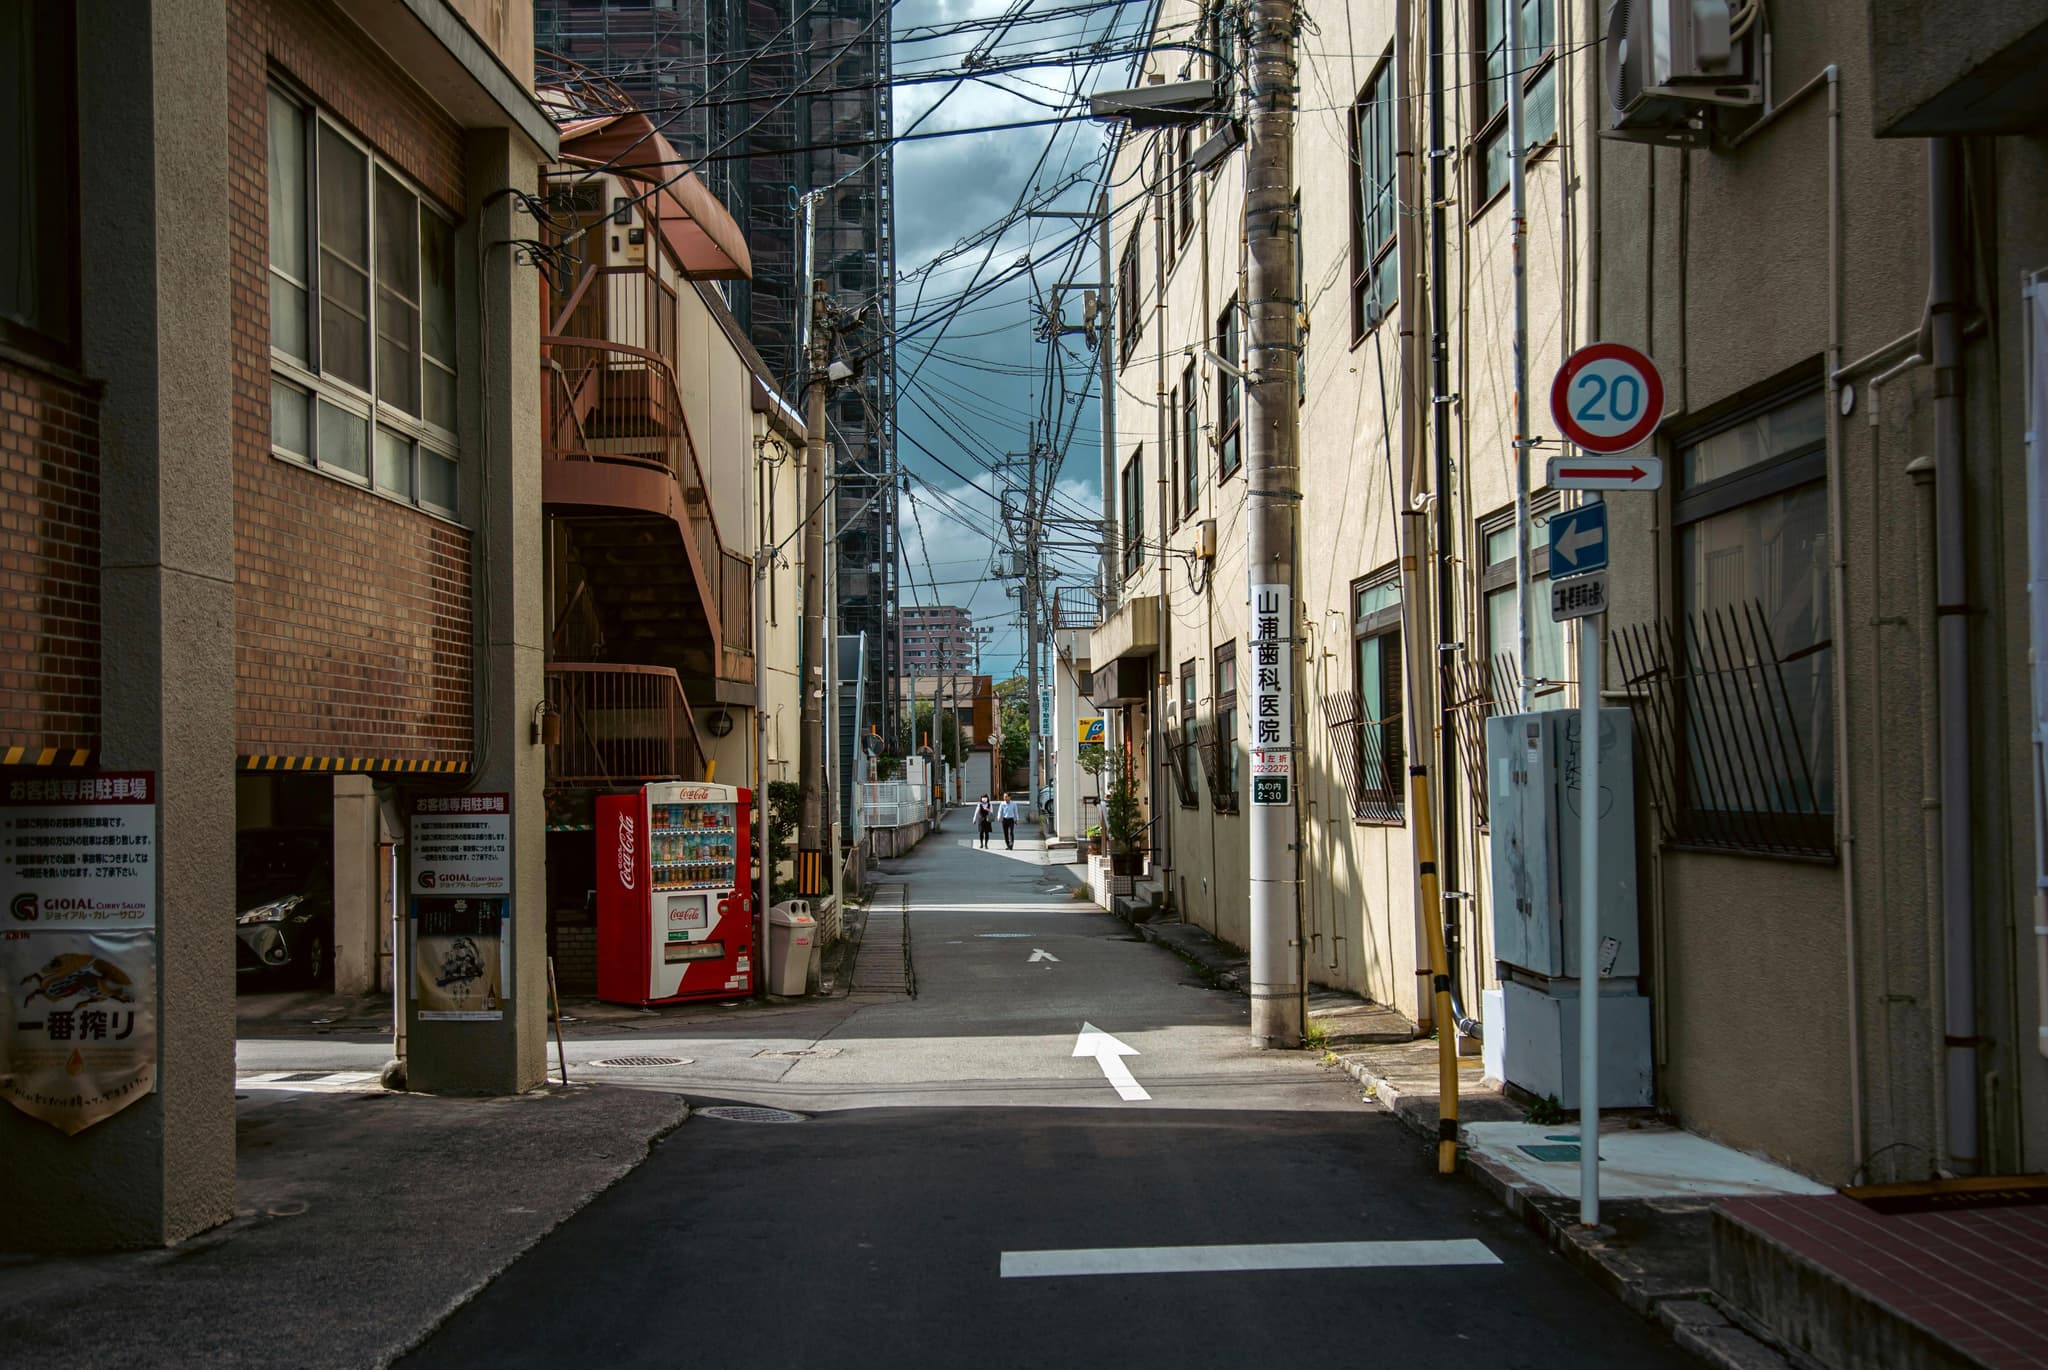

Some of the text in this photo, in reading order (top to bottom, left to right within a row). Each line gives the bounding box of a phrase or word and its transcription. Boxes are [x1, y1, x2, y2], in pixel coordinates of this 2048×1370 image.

[1577, 374, 1640, 421] 20
[1258, 590, 1280, 744] 山浦歯科医院
[10, 778, 148, 801] お客様専用駐車場
[680, 787, 709, 800] Coca-Cola
[1257, 783, 1281, 791] 丸の内
[1258, 792, 1281, 800] 2-30
[416, 797, 505, 811] お客様専用駐車場
[619, 809, 635, 890] Coca-Cola
[44, 898, 95, 910] GIOIAL
[45, 910, 145, 921] ジョイアル・カレーサロン
[671, 907, 700, 921] Coca-Cola
[18, 1010, 135, 1040] 一番搾り
